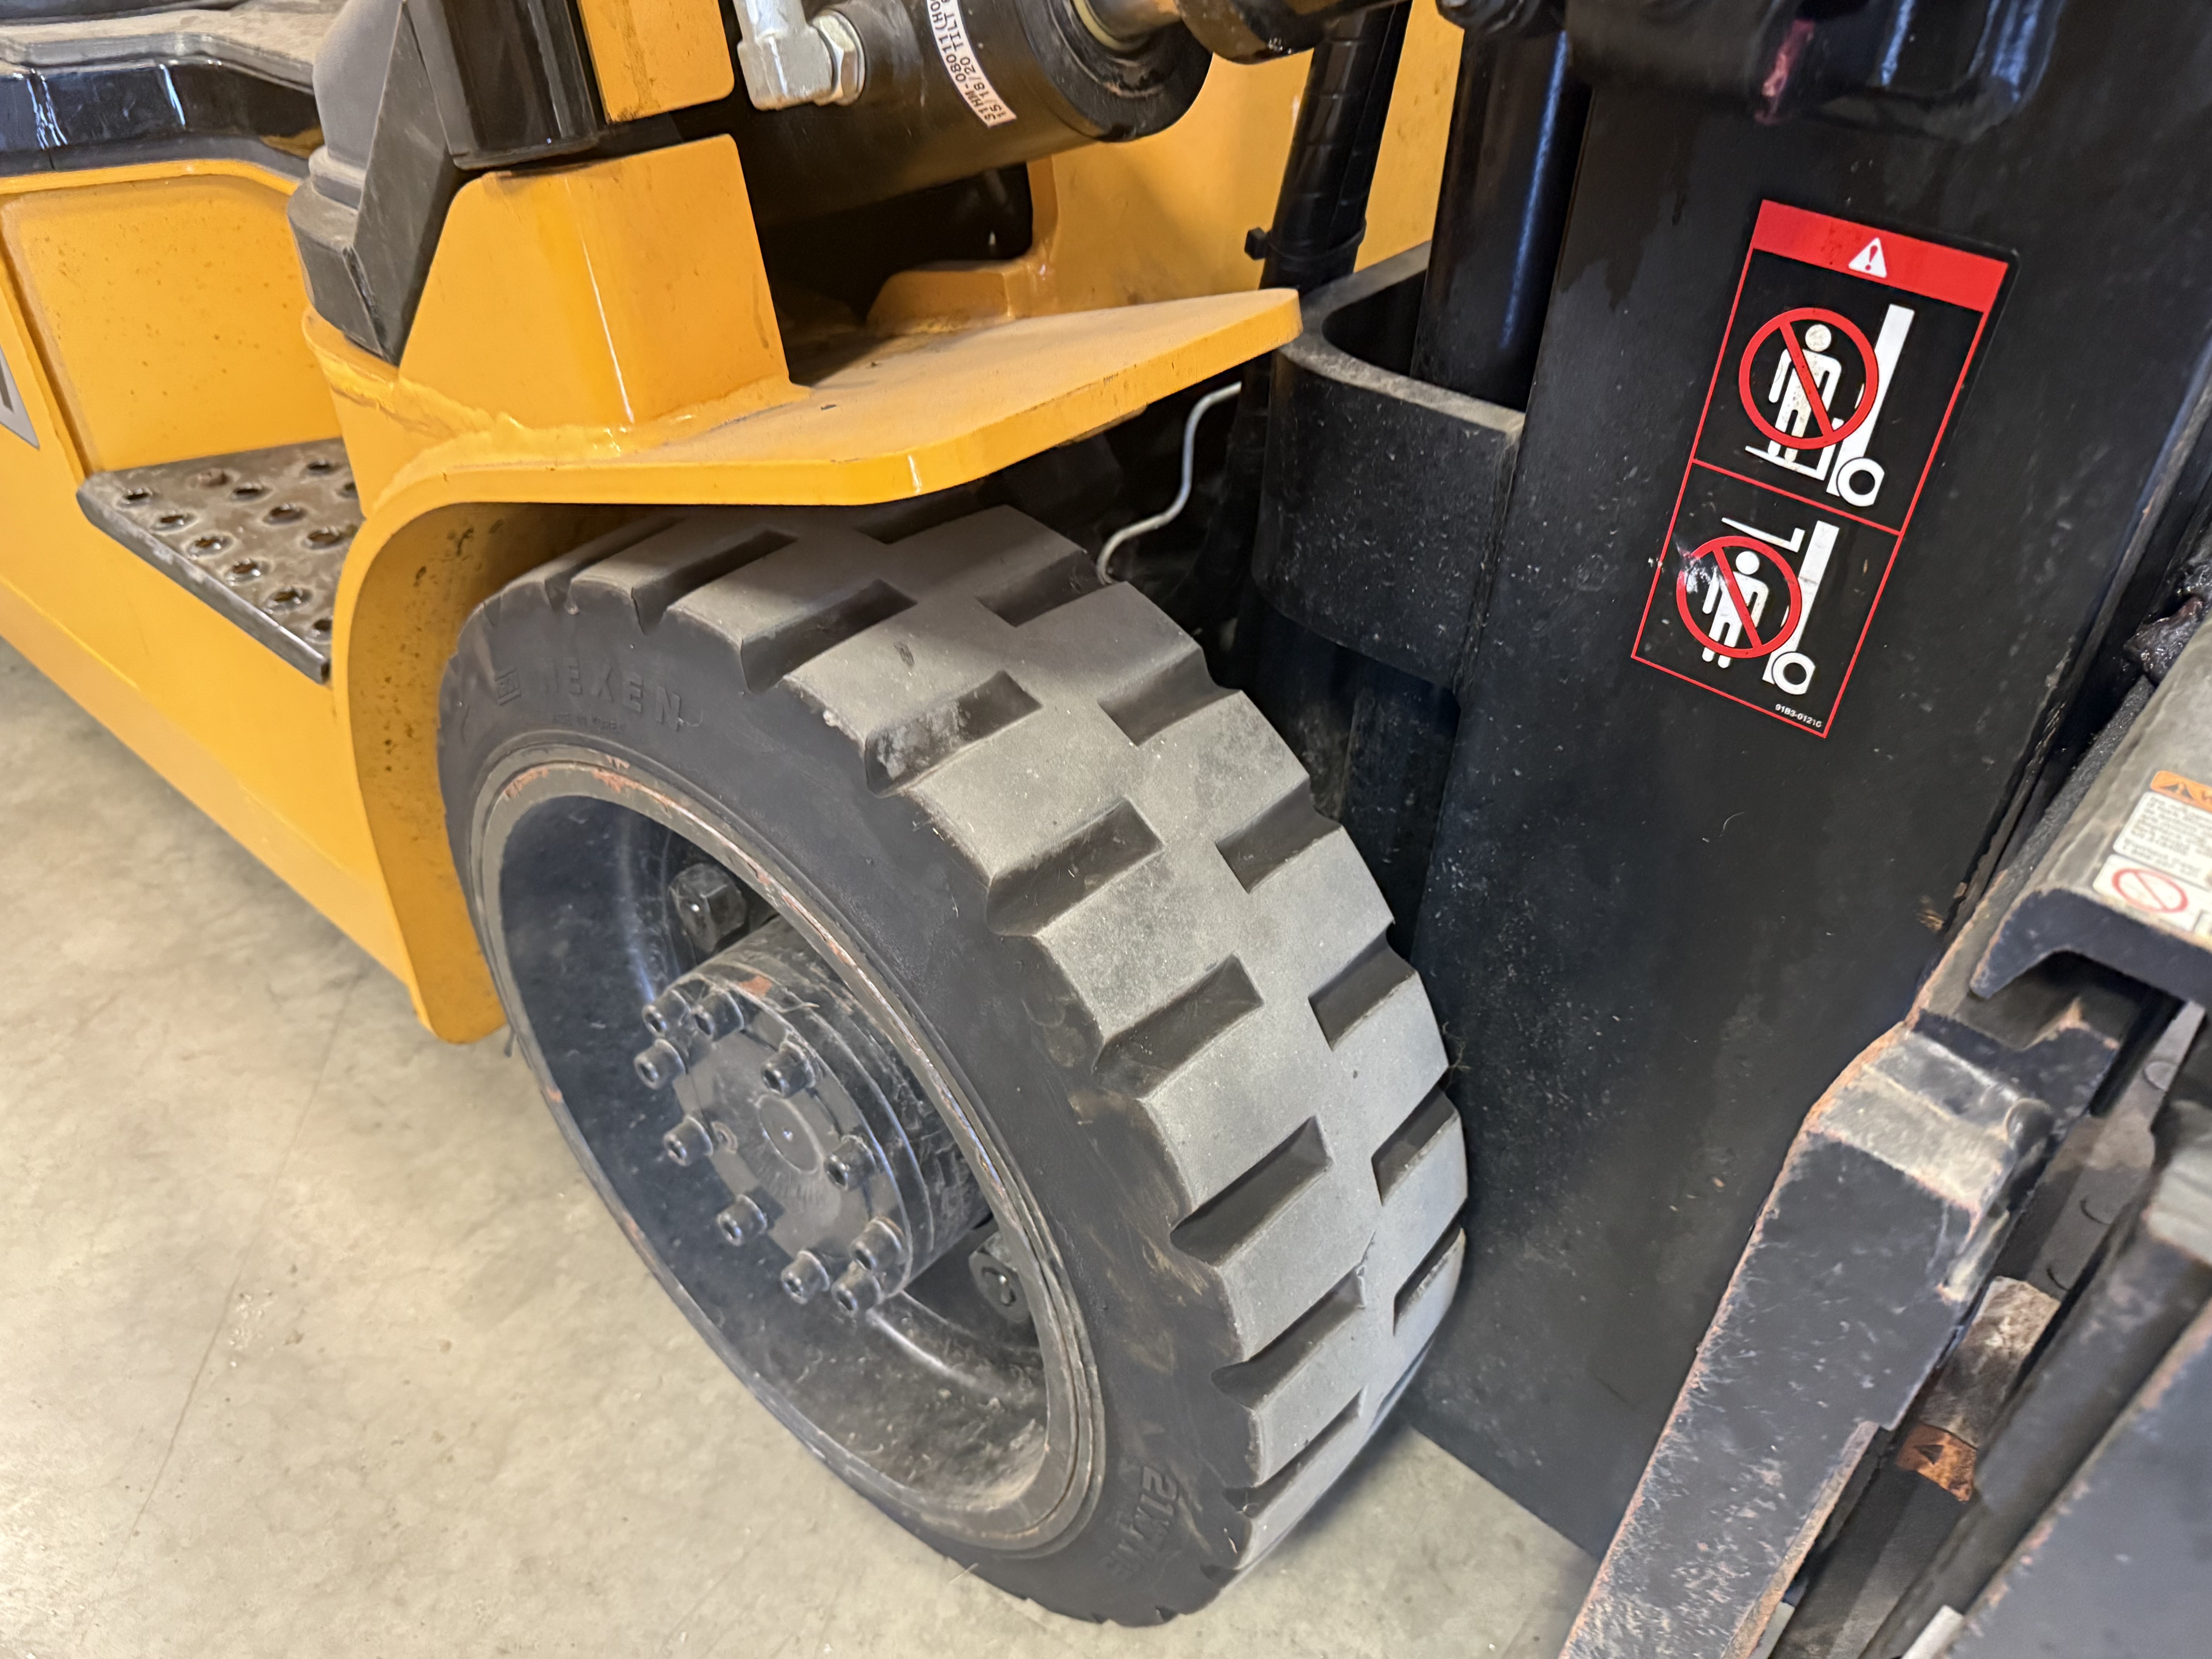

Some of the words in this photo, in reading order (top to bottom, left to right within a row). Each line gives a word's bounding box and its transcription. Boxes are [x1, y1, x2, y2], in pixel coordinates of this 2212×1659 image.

[930, 0, 996, 121] S1HM-08011(HO
[944, 12, 963, 52] TILT
[960, 57, 1006, 117] 15/18/20
